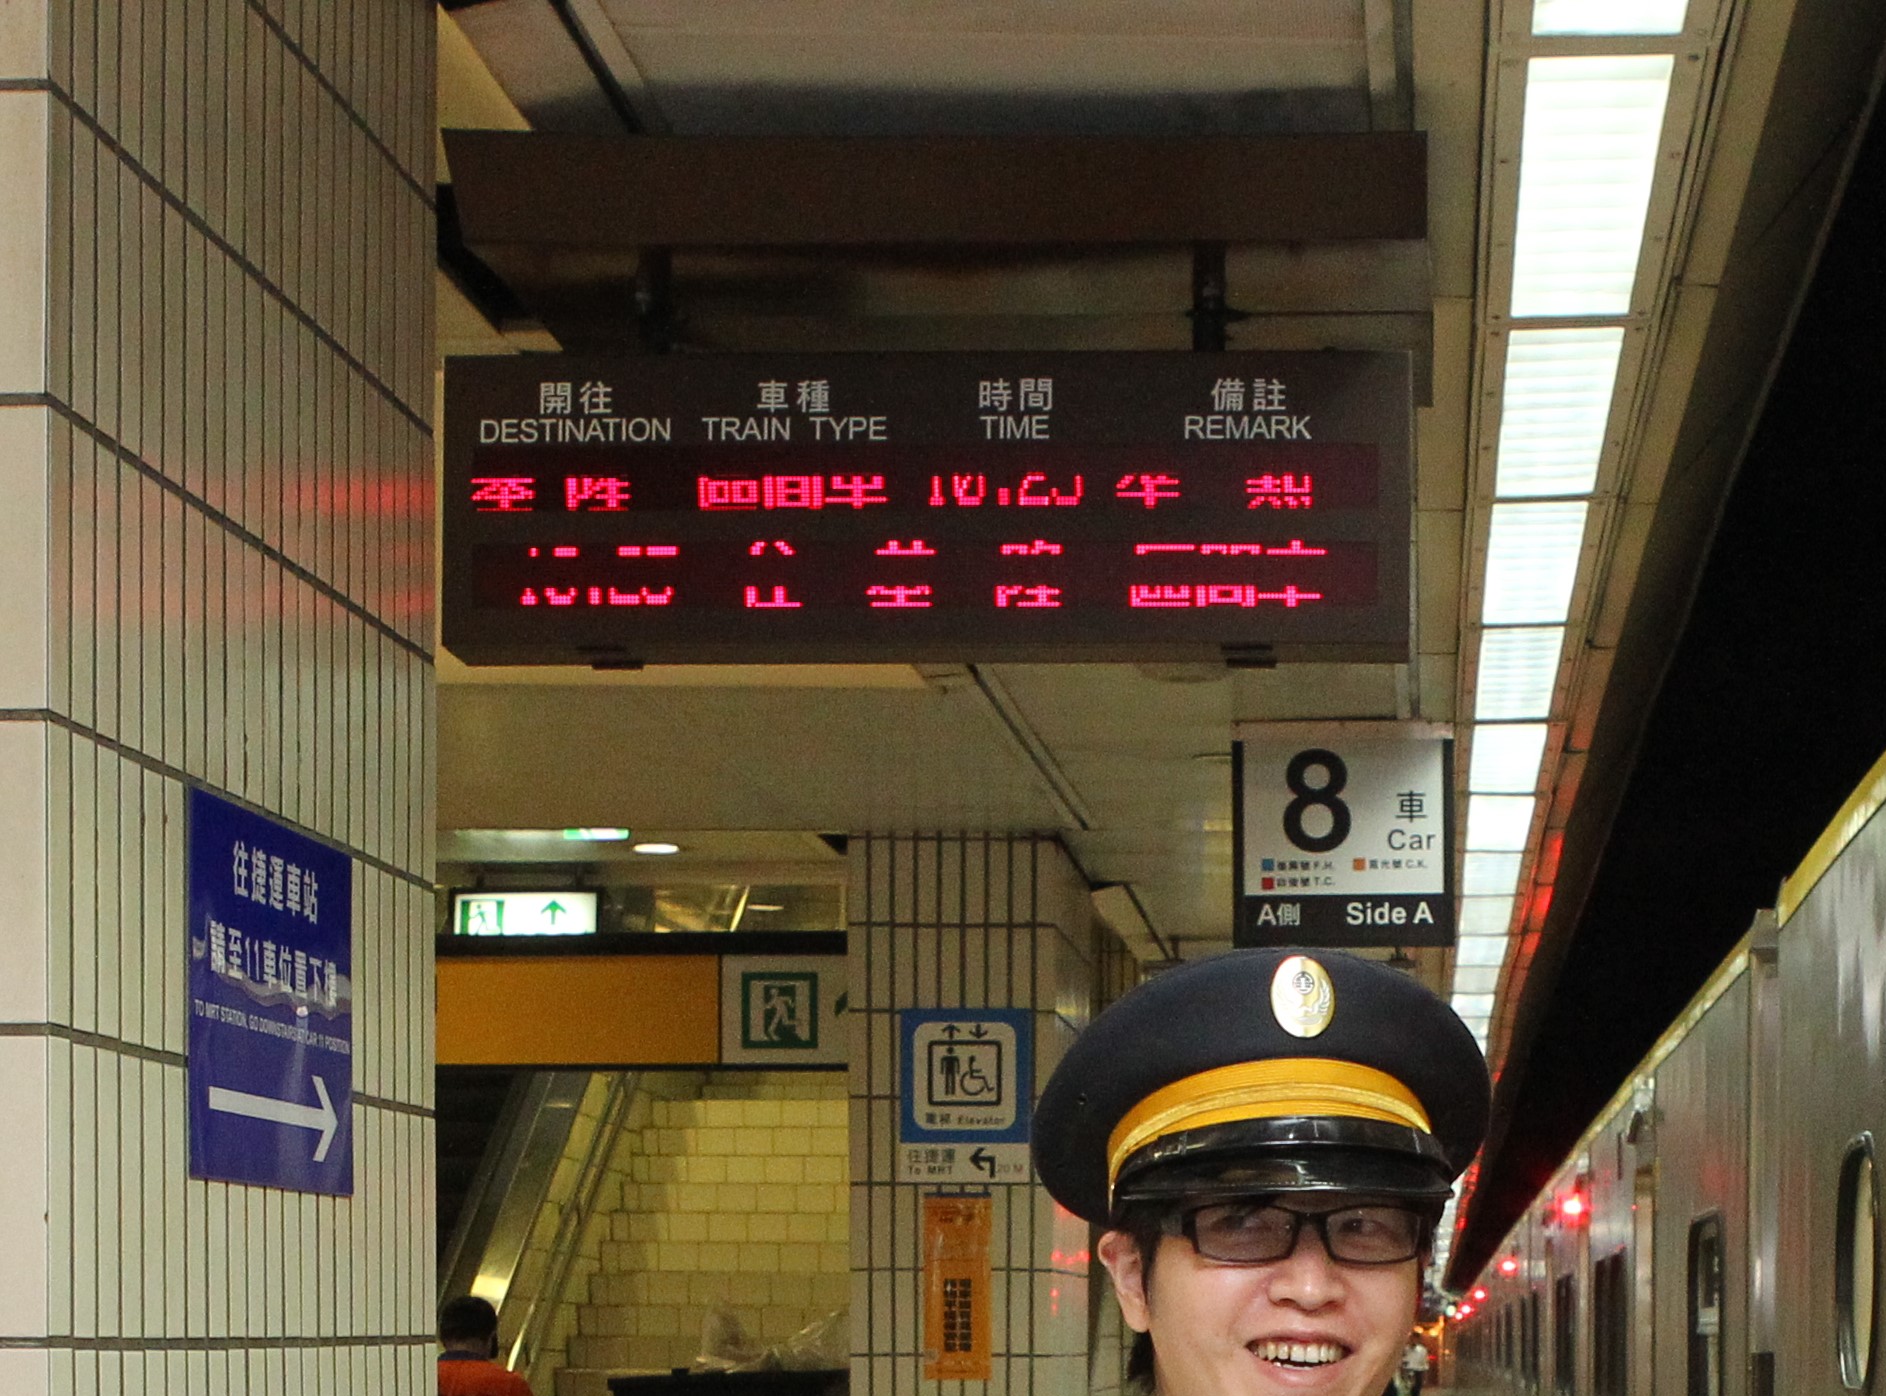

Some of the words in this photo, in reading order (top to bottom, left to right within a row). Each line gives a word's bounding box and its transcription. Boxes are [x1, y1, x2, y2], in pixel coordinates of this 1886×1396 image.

[539, 381, 613, 414] 開往
[757, 380, 831, 413] 車種
[978, 378, 1053, 411] 時間
[1210, 378, 1286, 412] 備註
[480, 417, 672, 443] DESTINATION
[702, 416, 791, 441] TRAIN
[809, 416, 888, 441] TYPE
[980, 415, 1050, 440] TIME
[1184, 415, 1312, 440] REMARK
[1283, 748, 1352, 853] 8
[1395, 790, 1428, 823] 車
[1388, 829, 1436, 851] Car
[232, 840, 319, 925] 往捷運車站
[1257, 903, 1301, 926] A側
[1346, 902, 1407, 925] Side
[1412, 901, 1434, 924] A
[194, 999, 204, 1017] TO
[249, 1015, 259, 1031] GO
[306, 1030, 317, 1046] CAR
[957, 1115, 1005, 1126] Elevator
[927, 1165, 953, 1175] MRT
